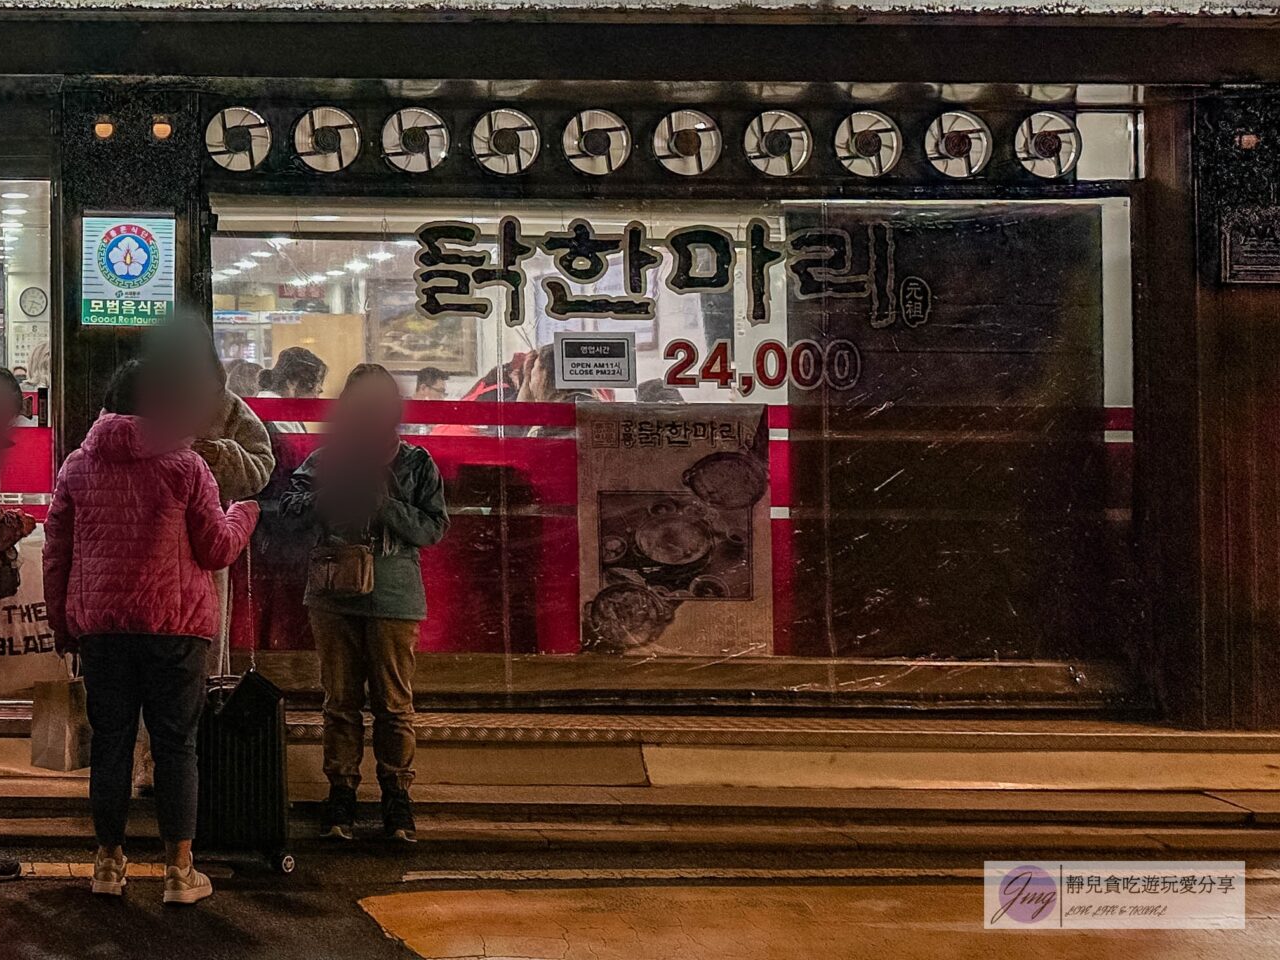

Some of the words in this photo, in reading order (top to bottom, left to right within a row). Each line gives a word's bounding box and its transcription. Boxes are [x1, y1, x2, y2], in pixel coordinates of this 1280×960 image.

[414, 214, 897, 328] 닭한마리
[90, 300, 167, 316] 모범음식점
[664, 339, 862, 396] 24,000
[1, 602, 48, 625] THE
